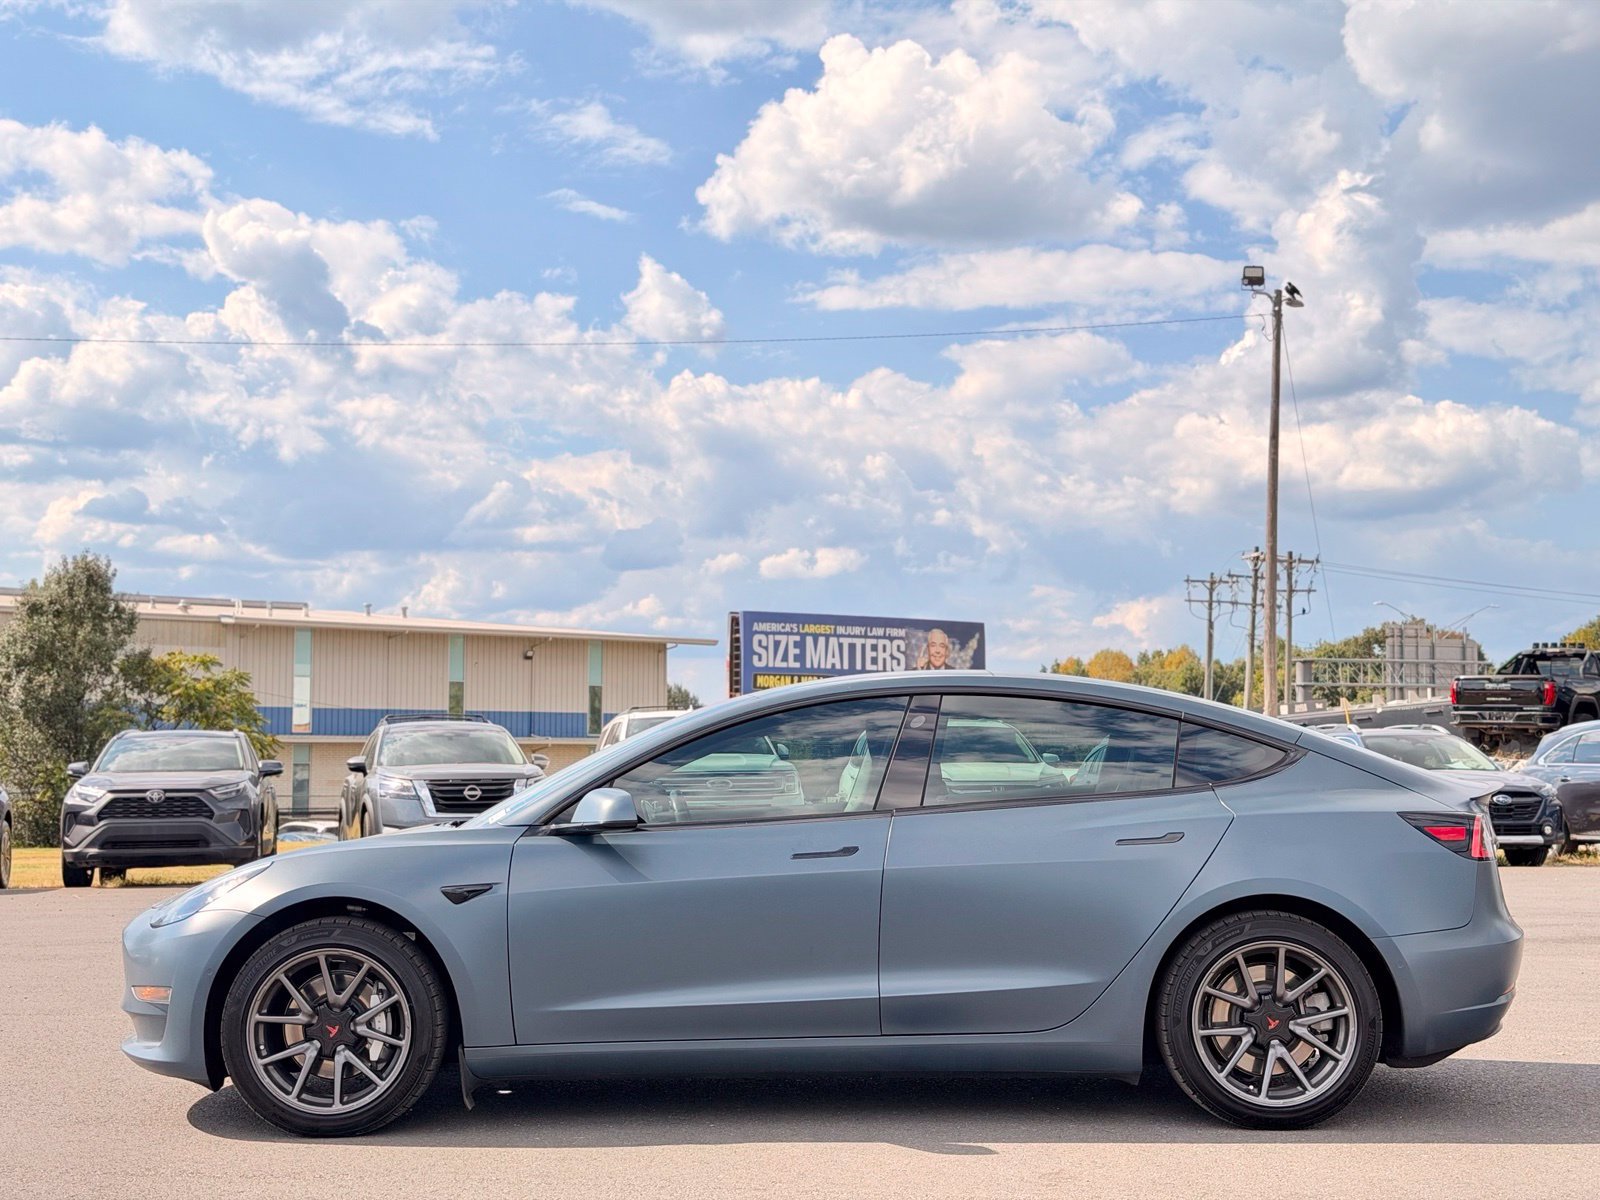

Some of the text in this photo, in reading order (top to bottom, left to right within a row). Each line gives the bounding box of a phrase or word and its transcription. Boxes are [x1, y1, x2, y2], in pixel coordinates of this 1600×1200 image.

[752, 622, 906, 637] AMERICA'S LARGEST INJURY LAW FIRM
[752, 633, 906, 672] SIZE MATTERS
